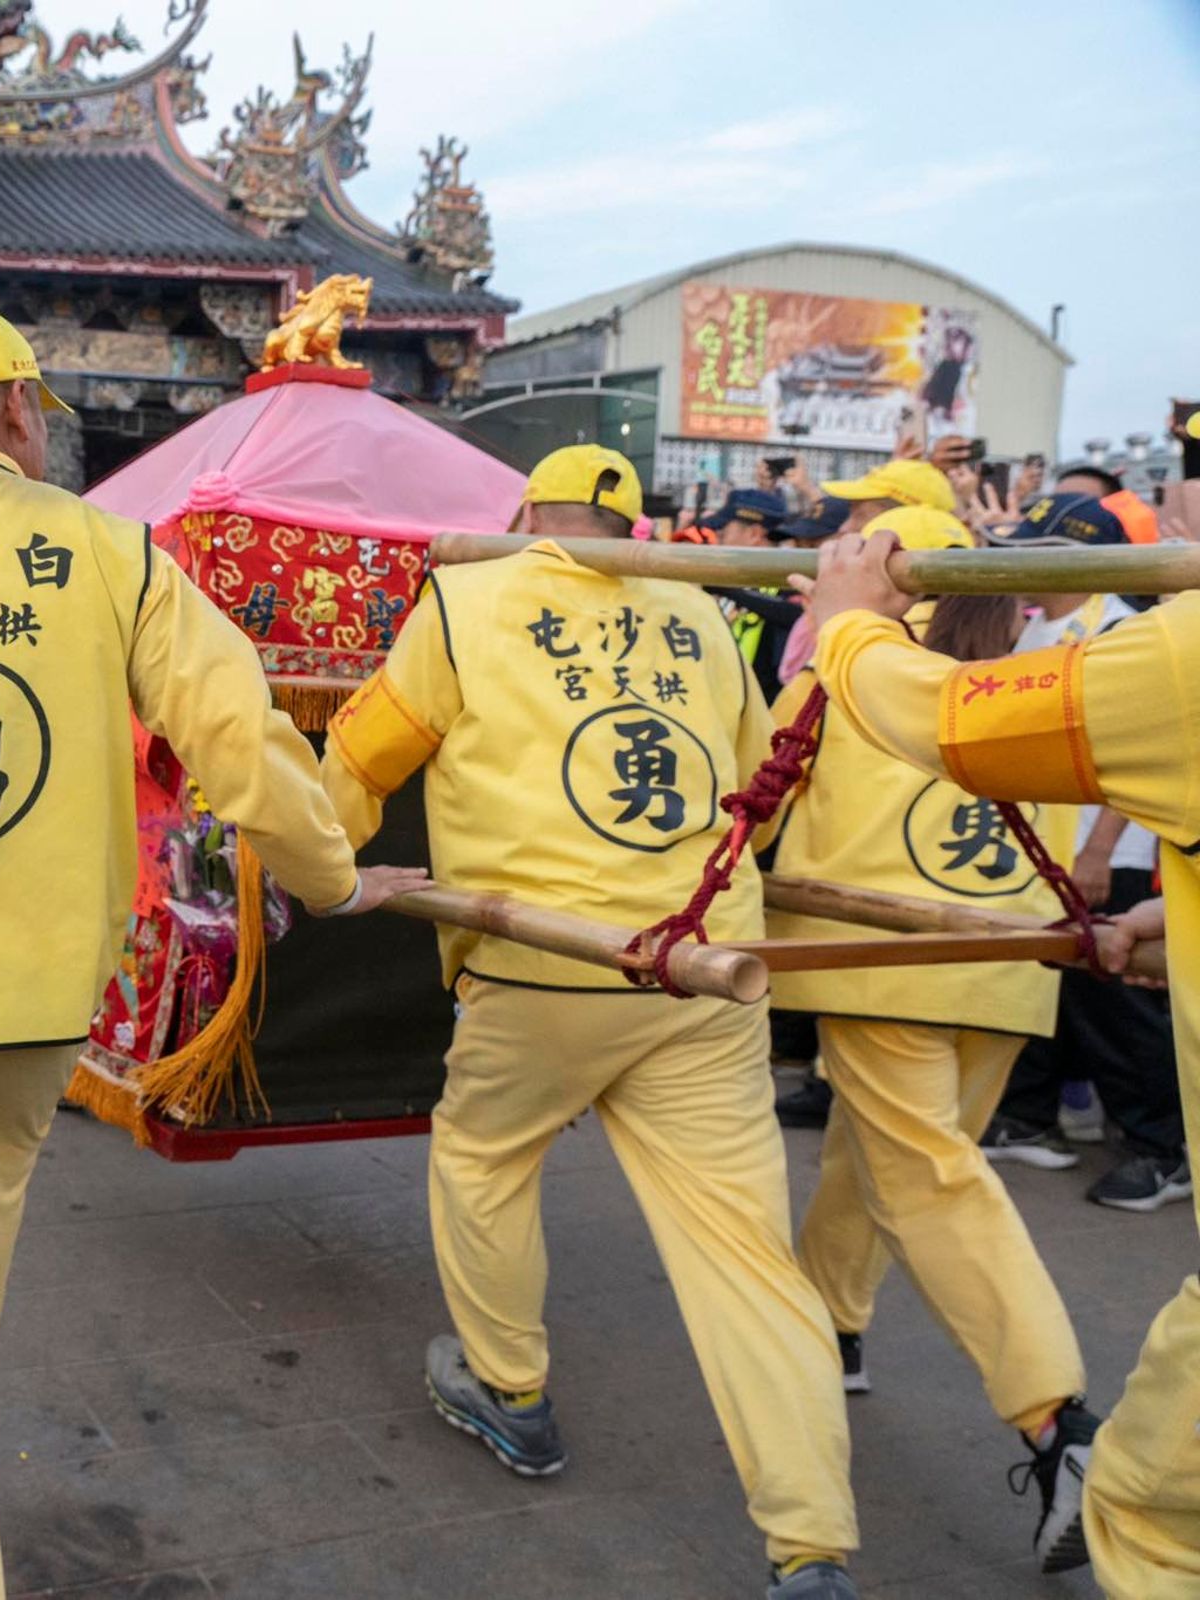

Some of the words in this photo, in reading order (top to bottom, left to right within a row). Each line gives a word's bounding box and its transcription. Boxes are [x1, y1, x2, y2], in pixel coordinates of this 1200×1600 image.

[526, 606, 702, 661] 白沙屯
[555, 665, 688, 705] 拱天宮
[608, 719, 686, 832] 勇
